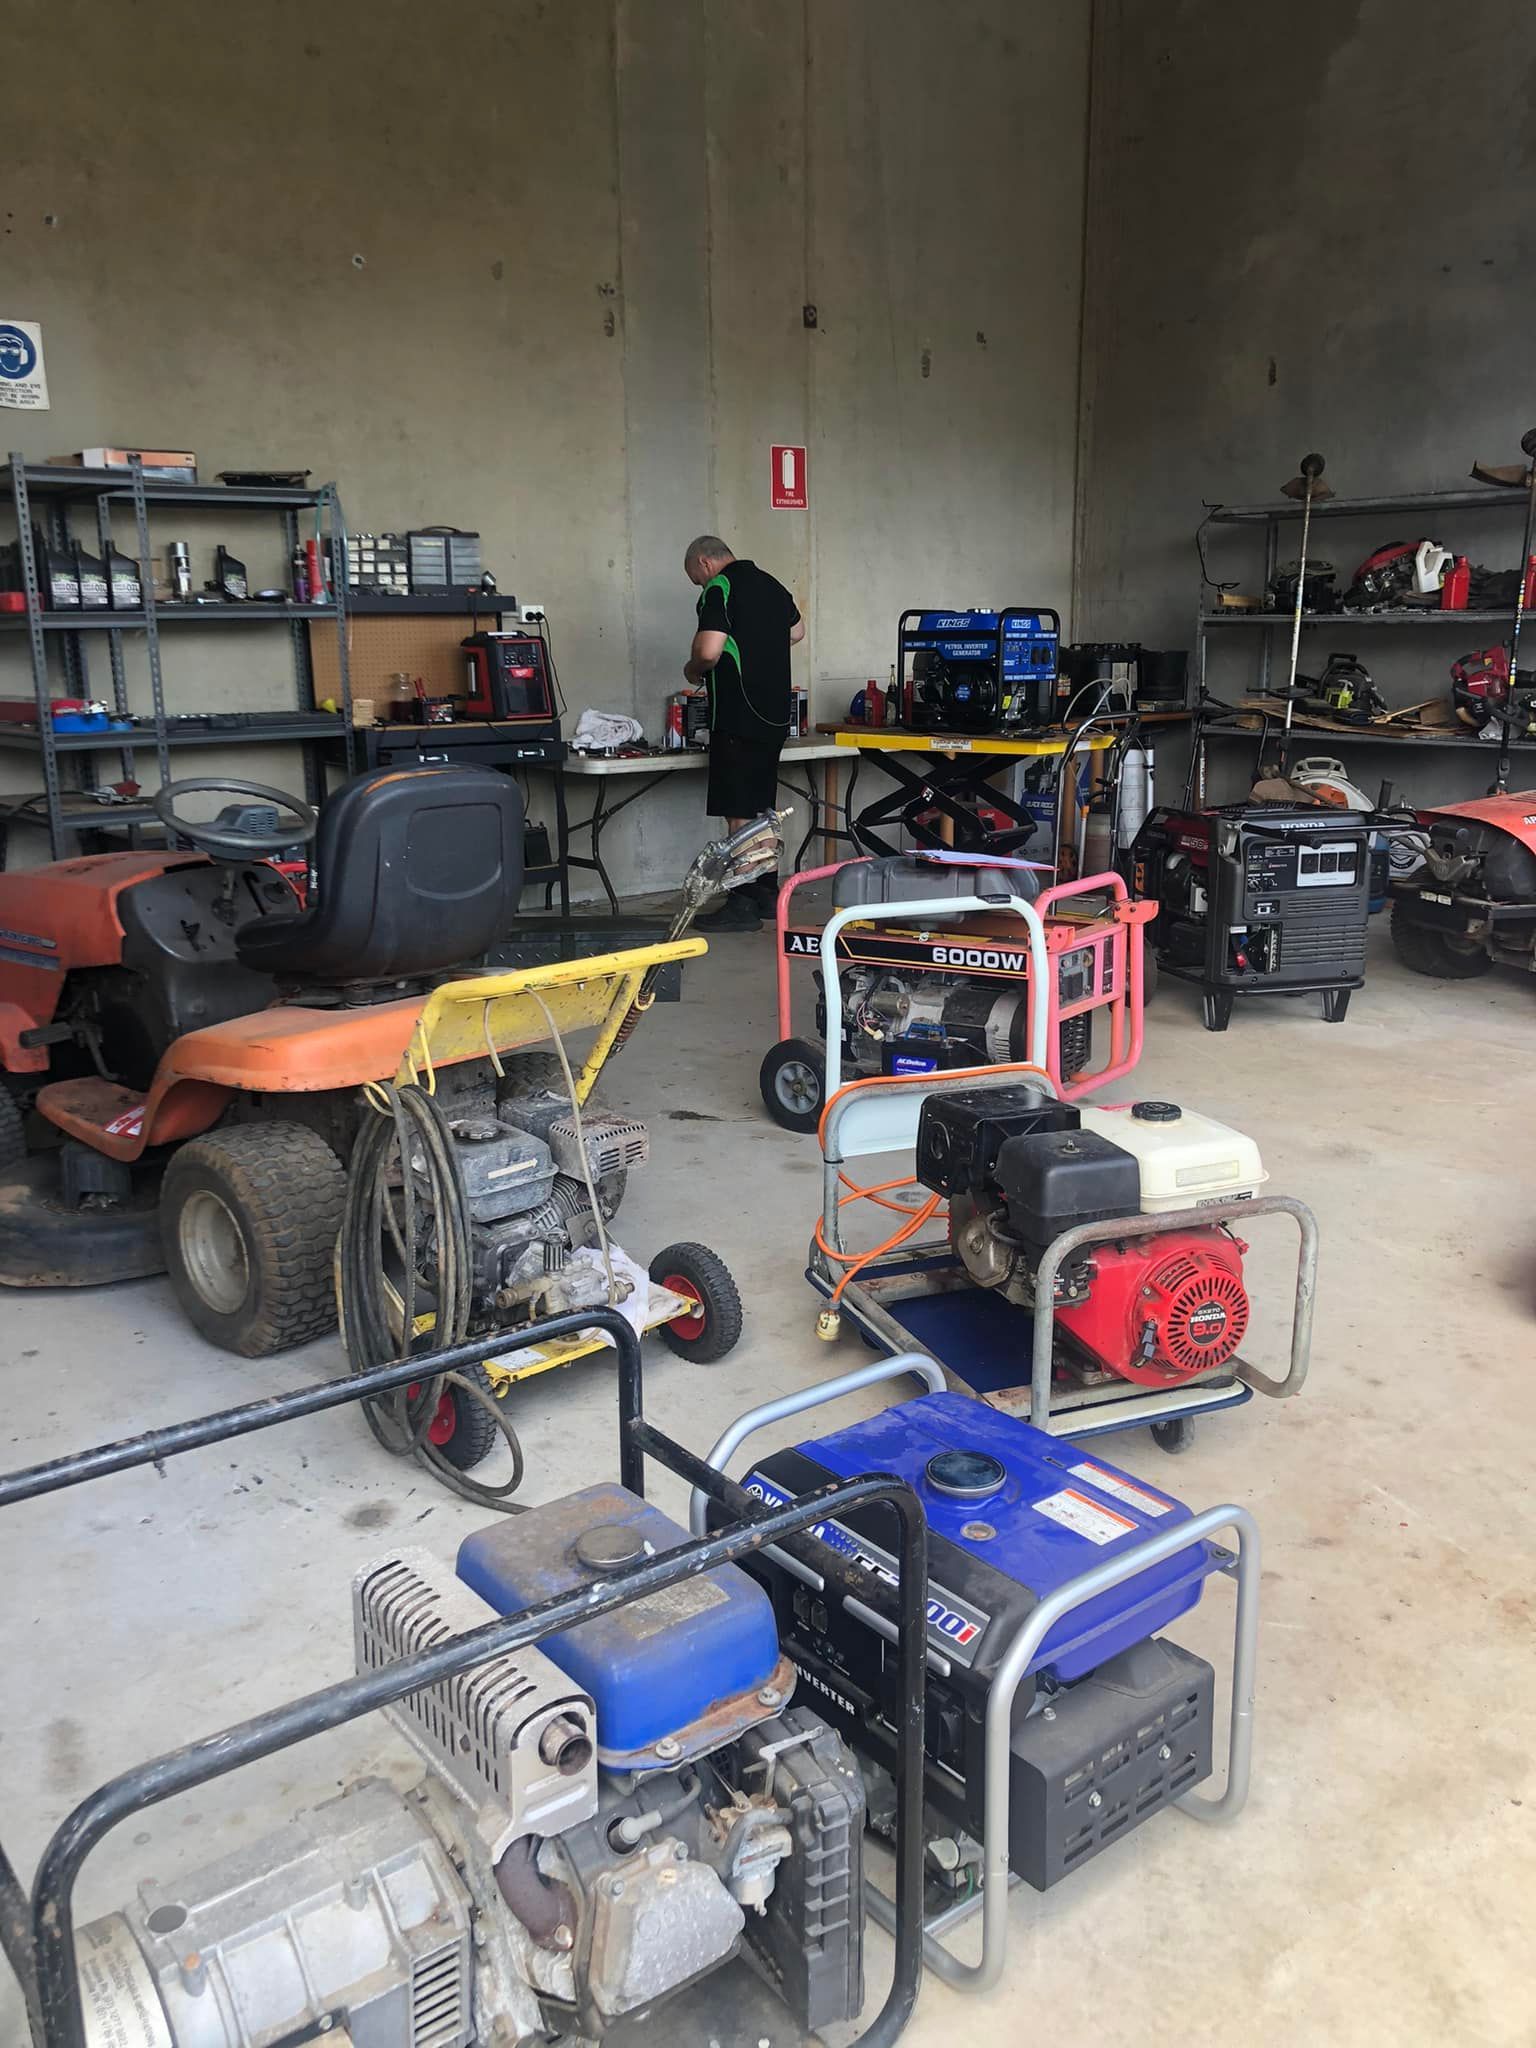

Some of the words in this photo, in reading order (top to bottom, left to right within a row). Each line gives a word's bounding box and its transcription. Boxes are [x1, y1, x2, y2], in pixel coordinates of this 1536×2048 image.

[935, 618, 971, 628] KINGS
[1011, 619, 1032, 629] KINGS
[790, 935, 820, 953] AE
[932, 946, 1024, 970] 6000W
[1190, 1312, 1227, 1323] HONDA
[1193, 1322, 1222, 1336] 9.0
